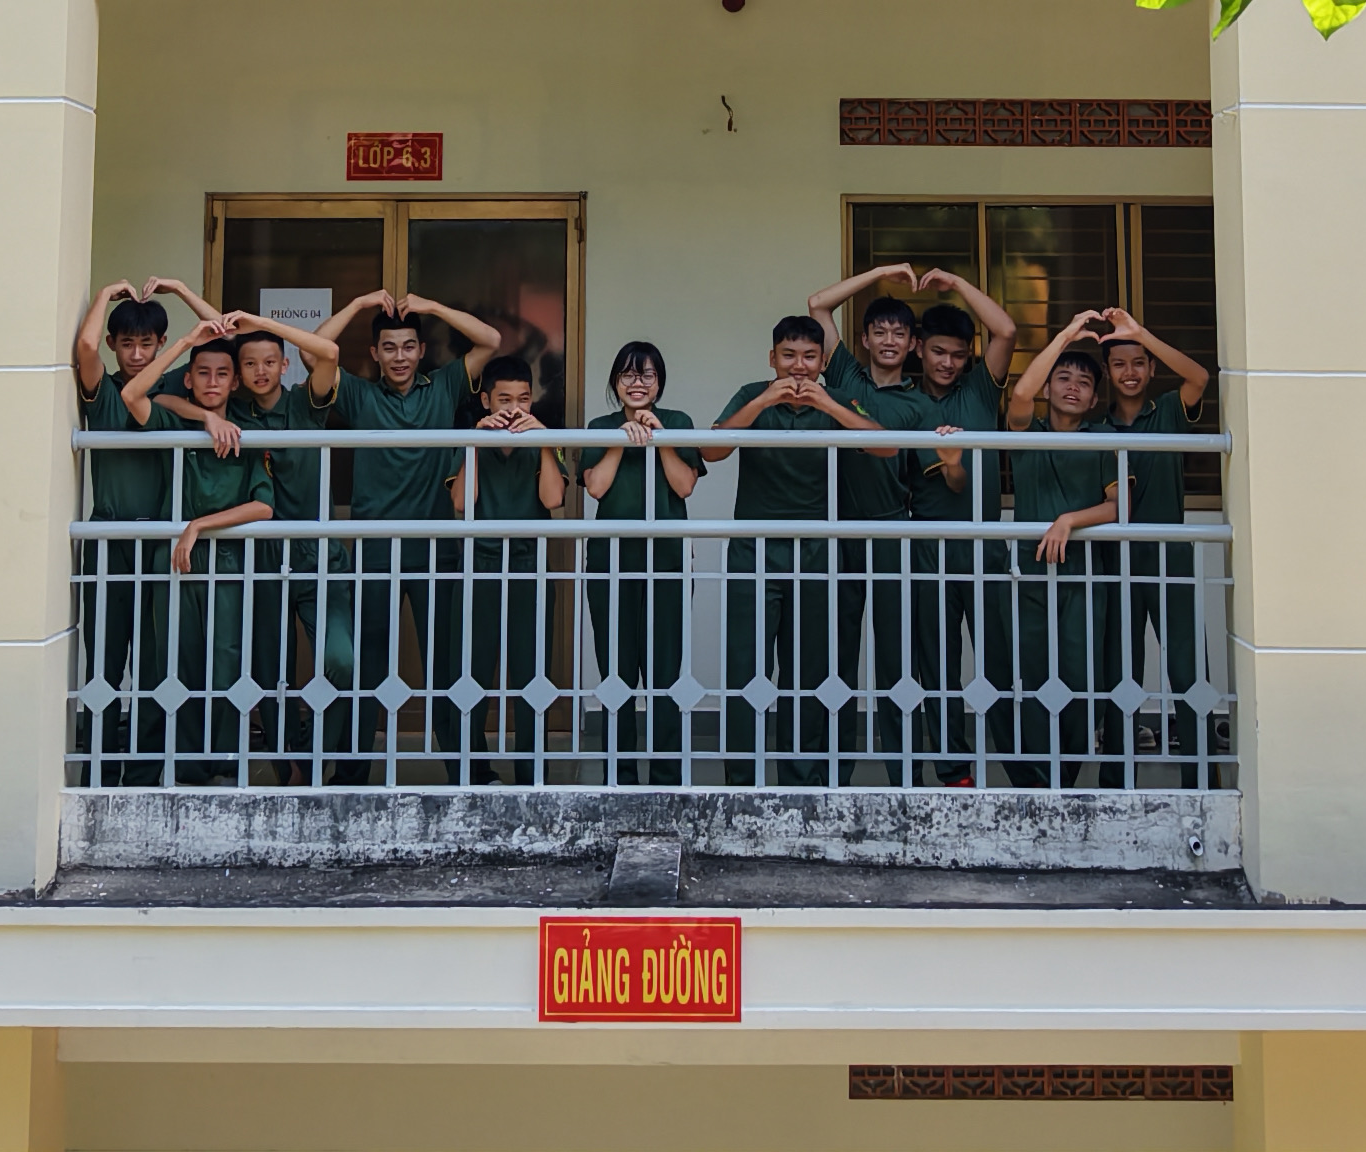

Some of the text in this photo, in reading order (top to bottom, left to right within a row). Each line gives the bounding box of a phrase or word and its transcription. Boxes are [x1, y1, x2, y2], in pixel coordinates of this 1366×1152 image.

[358, 140, 431, 168] LỚP 6.3
[271, 307, 322, 319] PHÒNG 04
[553, 928, 727, 1005] GIẢNG ĐƯỜNG
